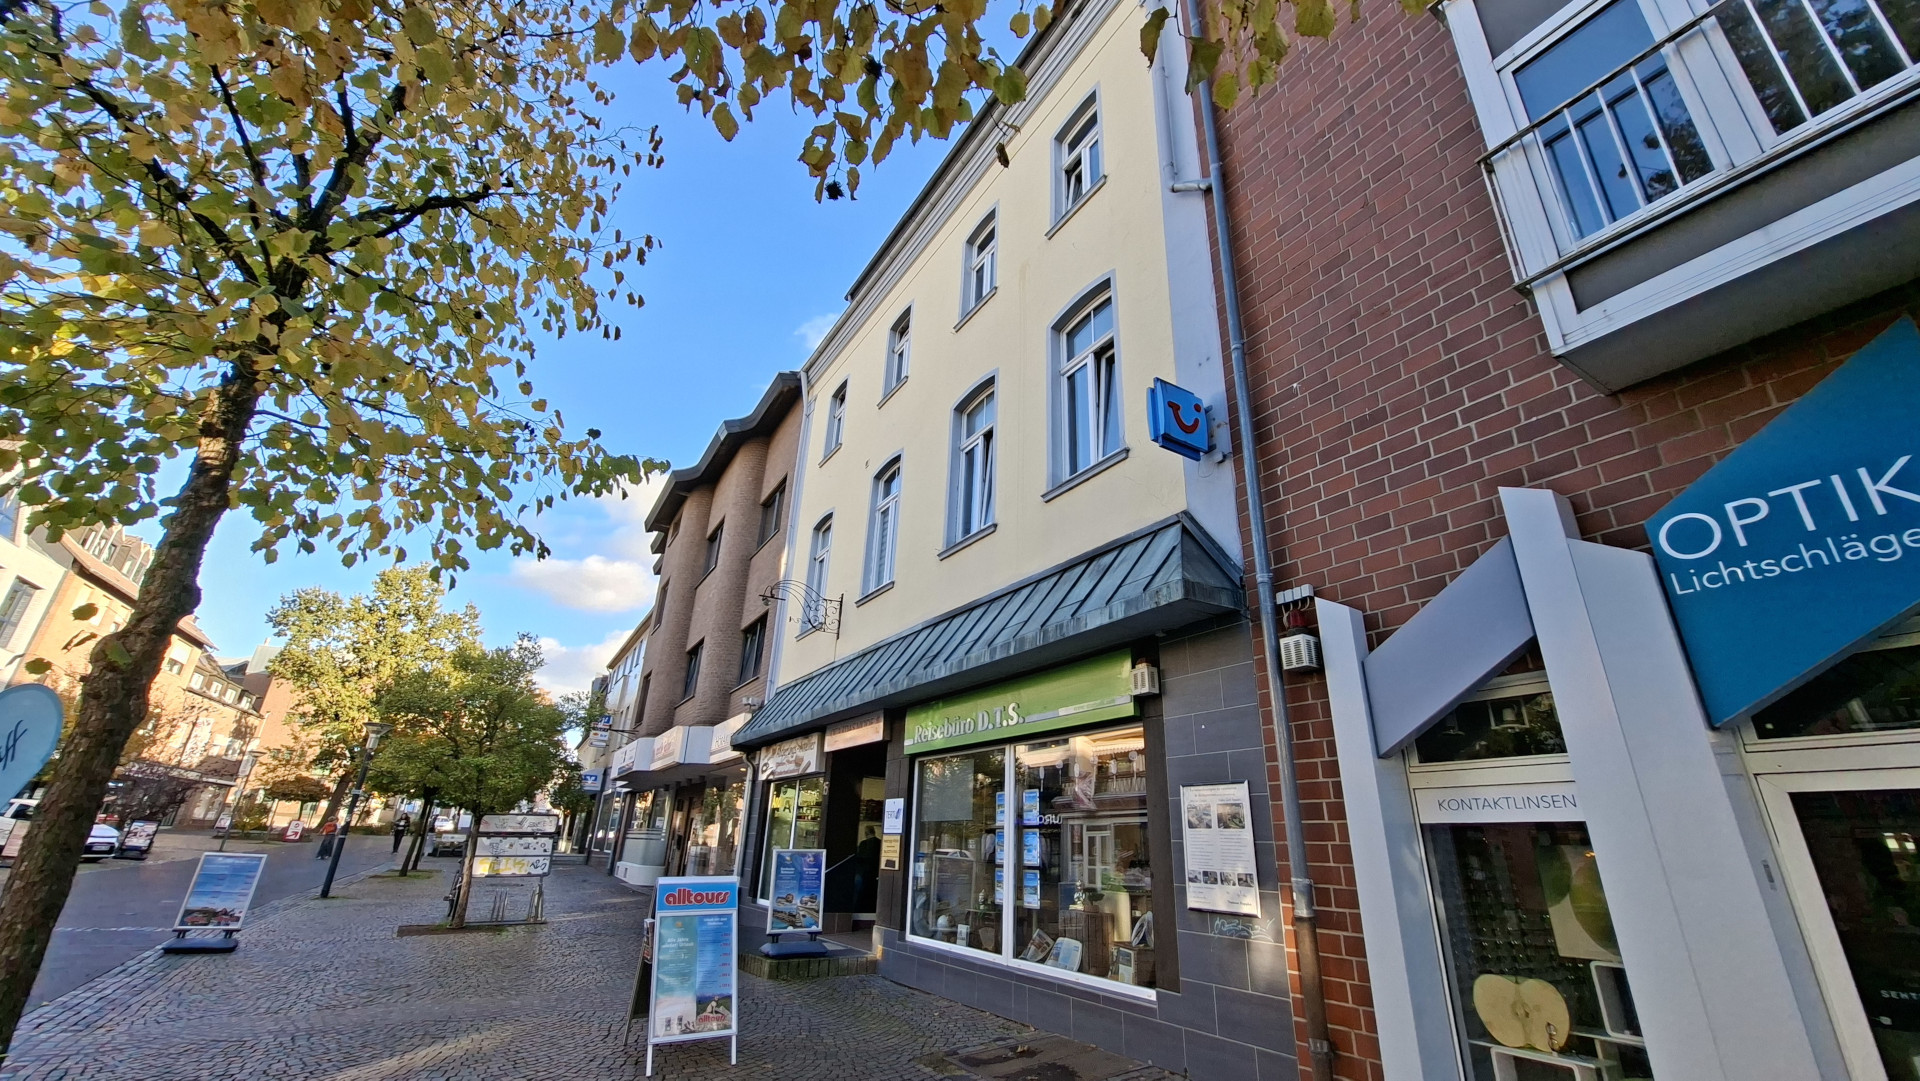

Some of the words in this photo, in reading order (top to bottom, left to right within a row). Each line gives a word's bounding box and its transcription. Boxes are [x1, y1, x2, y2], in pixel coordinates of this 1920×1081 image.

[1658, 454, 1920, 560] OPTIK
[914, 717, 975, 743] Reisebüro
[978, 702, 1025, 732] D.T.S.
[1437, 794, 1577, 812] KONTAKTLINSEN
[665, 888, 731, 906] alltours
